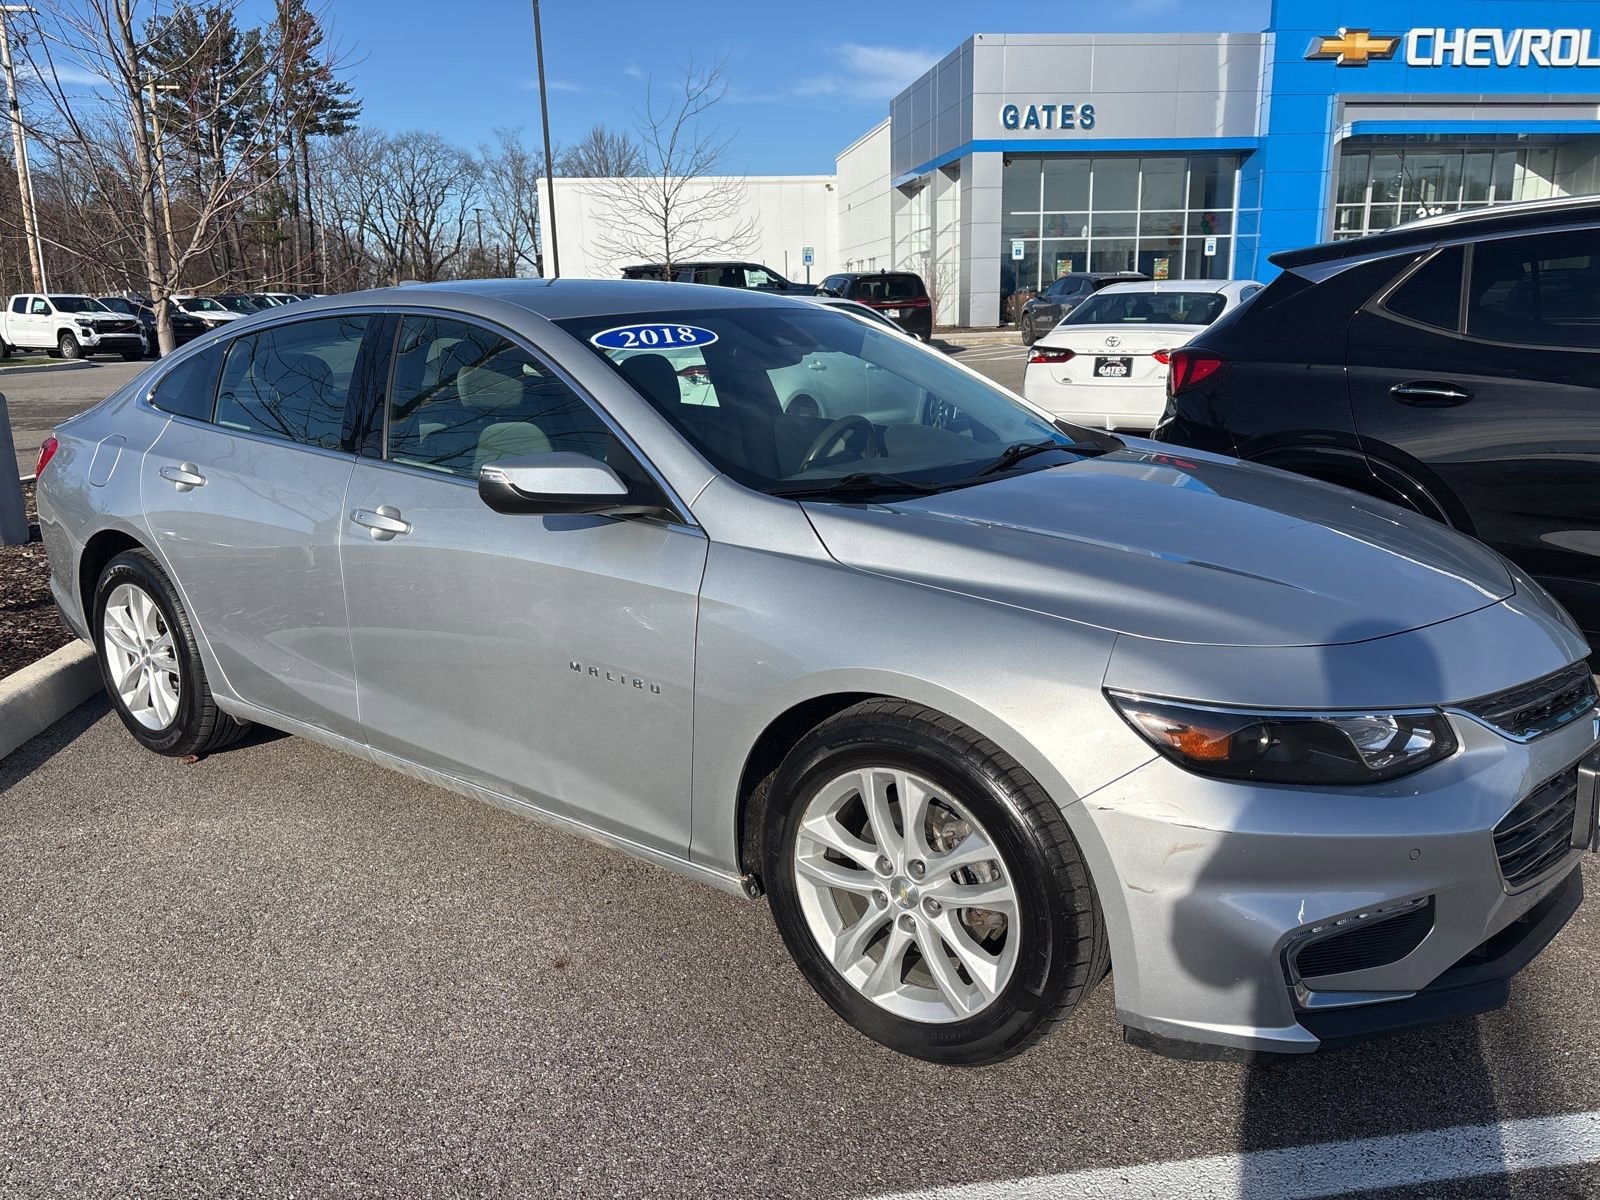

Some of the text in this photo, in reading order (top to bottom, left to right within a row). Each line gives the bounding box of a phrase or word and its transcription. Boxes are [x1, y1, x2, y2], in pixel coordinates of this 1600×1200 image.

[1406, 28, 1600, 66] CHEVROL
[1000, 104, 1096, 130] GATES
[618, 327, 697, 347] 2018
[1098, 366, 1128, 375] GATES
[569, 660, 661, 695] MALIBU
